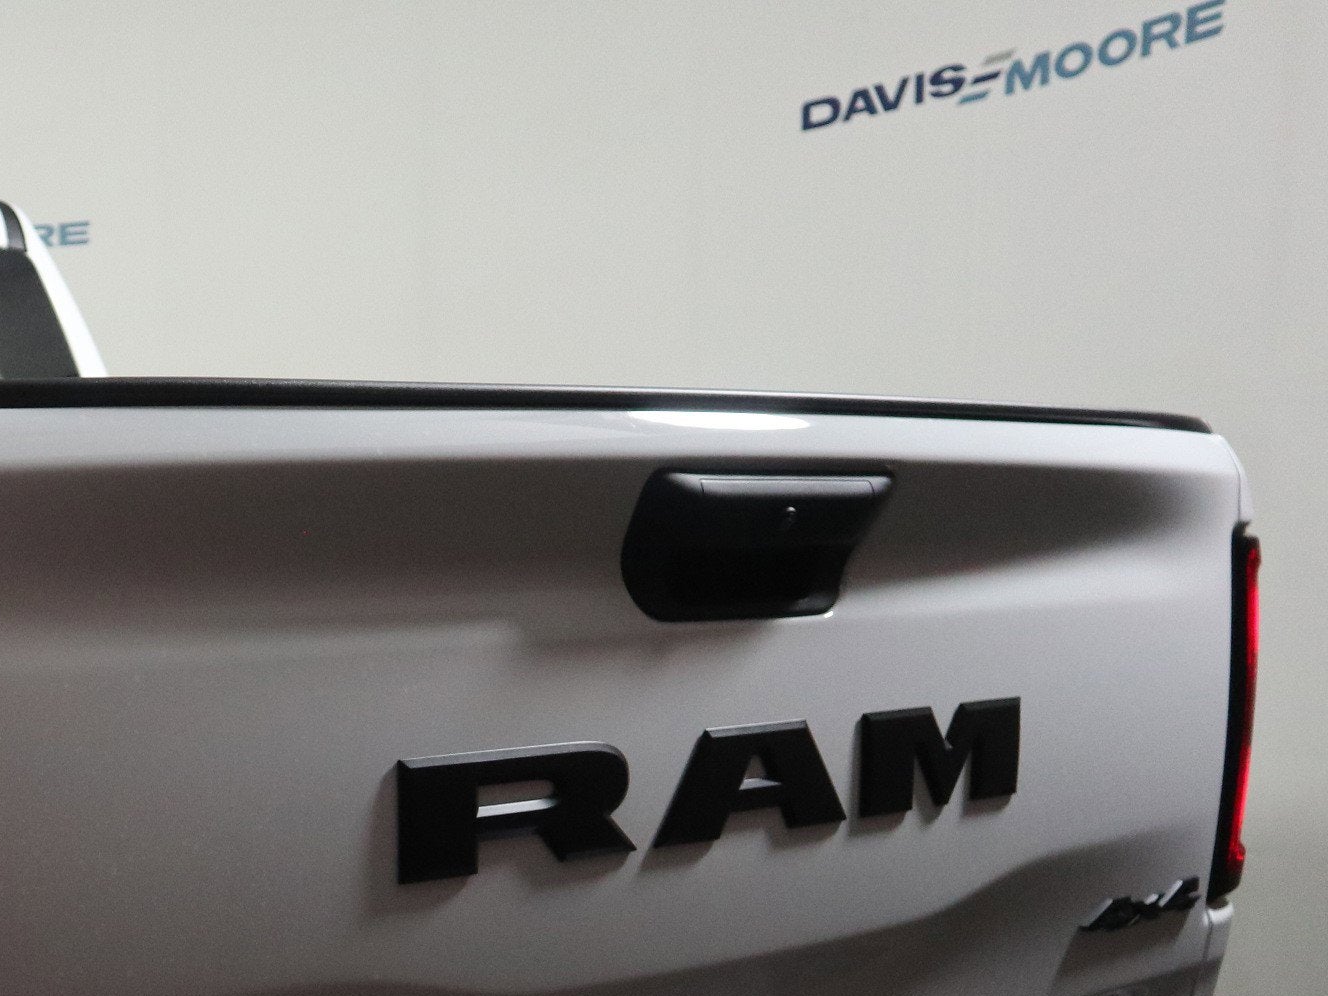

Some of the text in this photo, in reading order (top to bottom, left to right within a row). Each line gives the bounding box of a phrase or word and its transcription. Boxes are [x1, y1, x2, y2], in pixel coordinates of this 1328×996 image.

[800, 0, 1226, 131] DAVIS MOORE
[398, 696, 1021, 884] RAM
